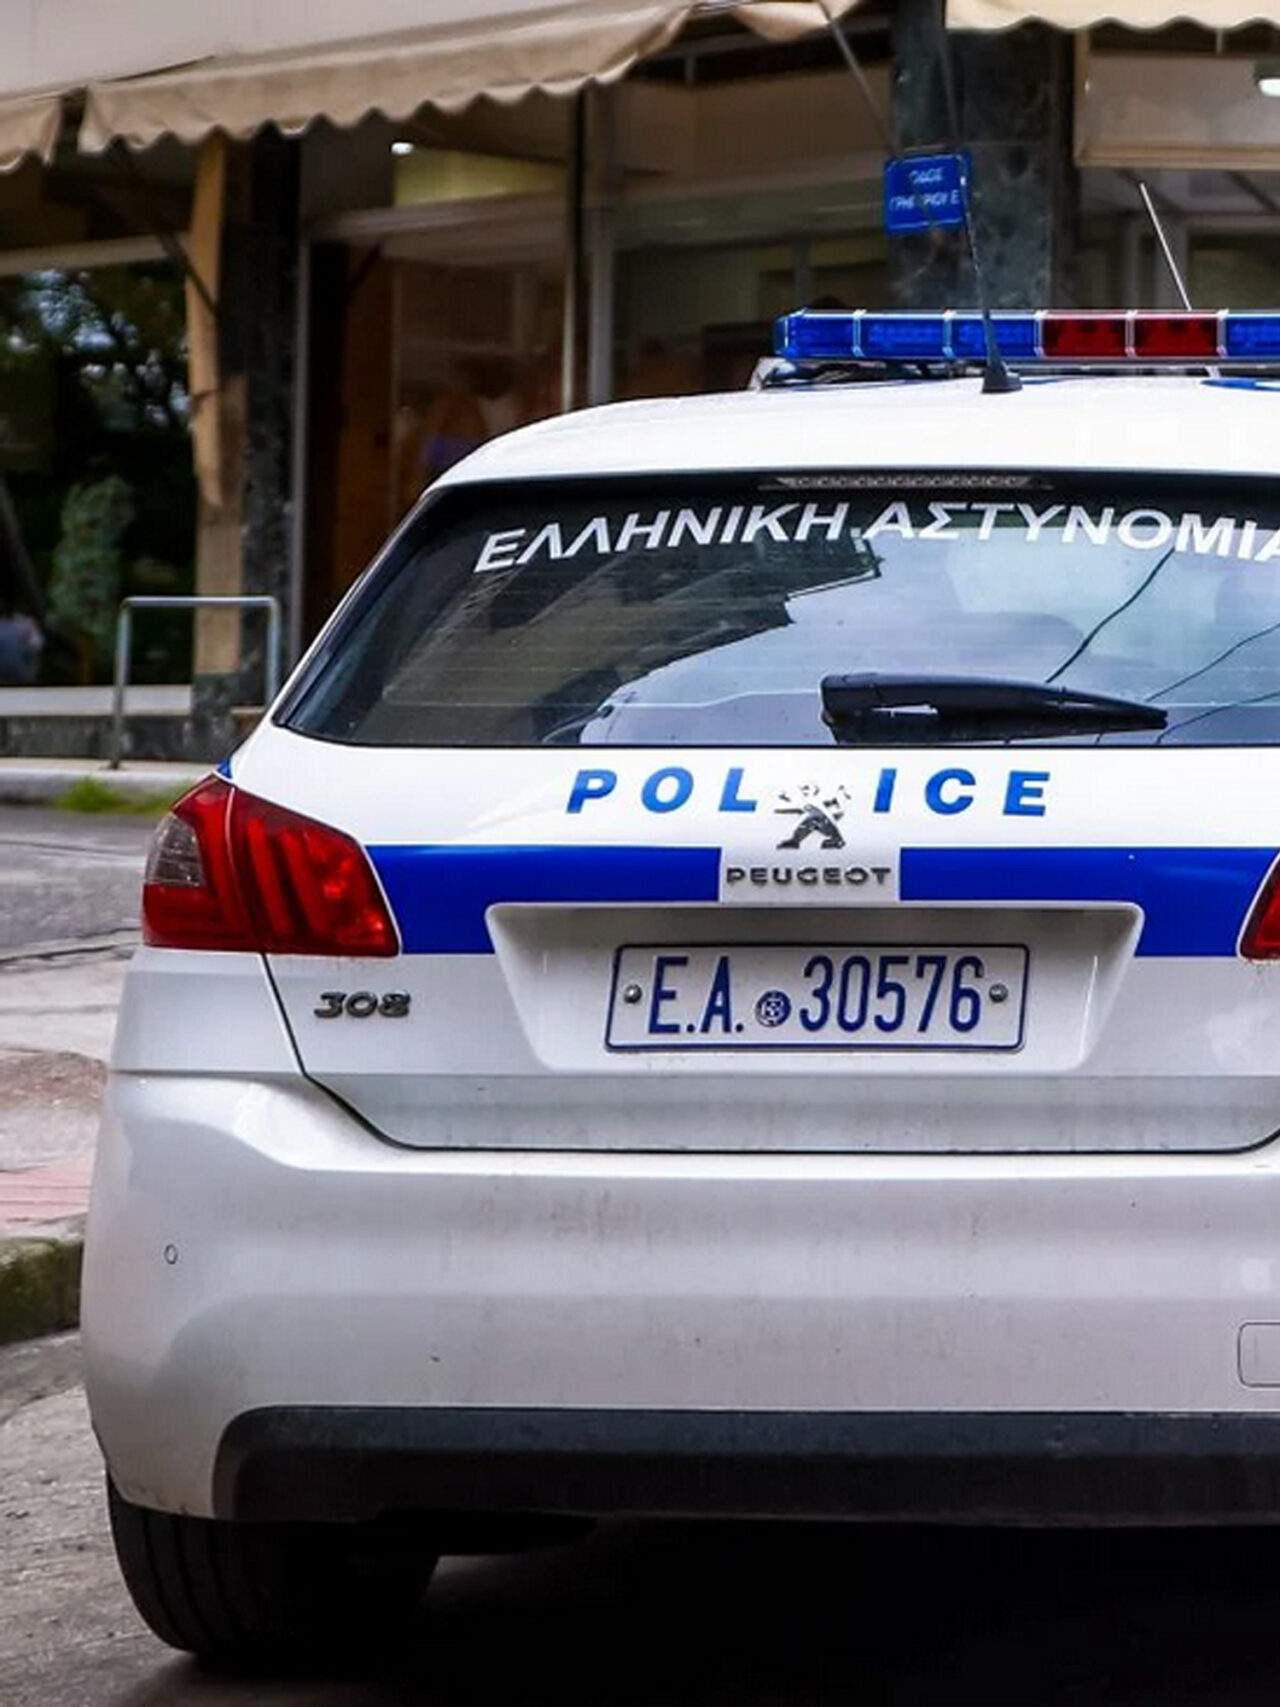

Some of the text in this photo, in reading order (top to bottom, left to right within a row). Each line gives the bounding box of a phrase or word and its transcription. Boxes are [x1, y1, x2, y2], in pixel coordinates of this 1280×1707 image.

[473, 502, 850, 573] ΕΛΛΗΝΙΚΗ
[726, 866, 891, 887] PEUGEOT
[313, 990, 411, 1018] 308
[799, 955, 985, 1033] 30576
